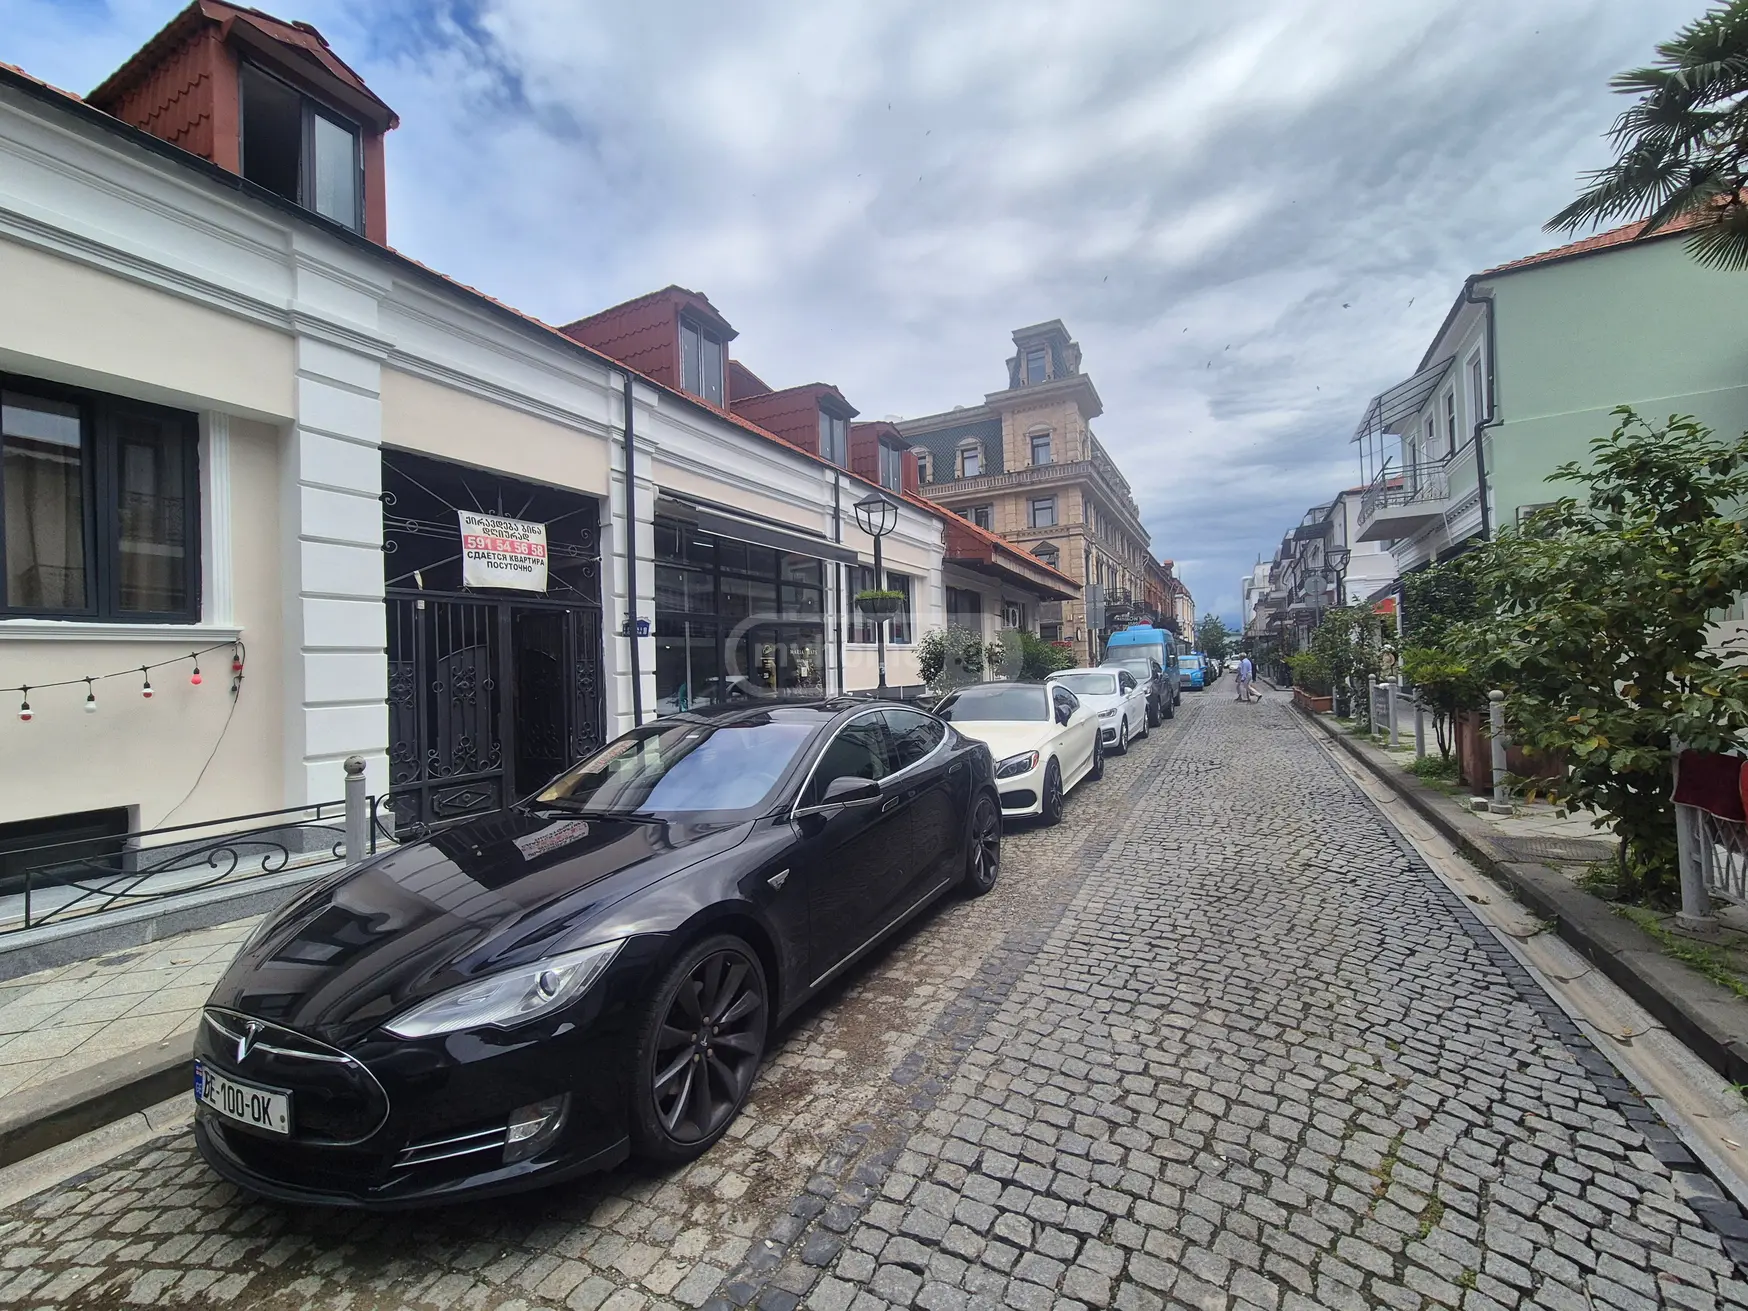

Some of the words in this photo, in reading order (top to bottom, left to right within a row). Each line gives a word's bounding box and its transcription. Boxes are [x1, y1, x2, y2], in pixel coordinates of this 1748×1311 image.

[482, 527, 530, 541] დღიურად
[521, 524, 542, 535] ბინა
[467, 536, 493, 550] 591
[496, 539, 512, 552] 54
[514, 542, 529, 554] 56
[531, 544, 544, 556] 58
[509, 554, 545, 566] КВАРТИРА
[487, 561, 533, 573] ПОСУТОЧНО
